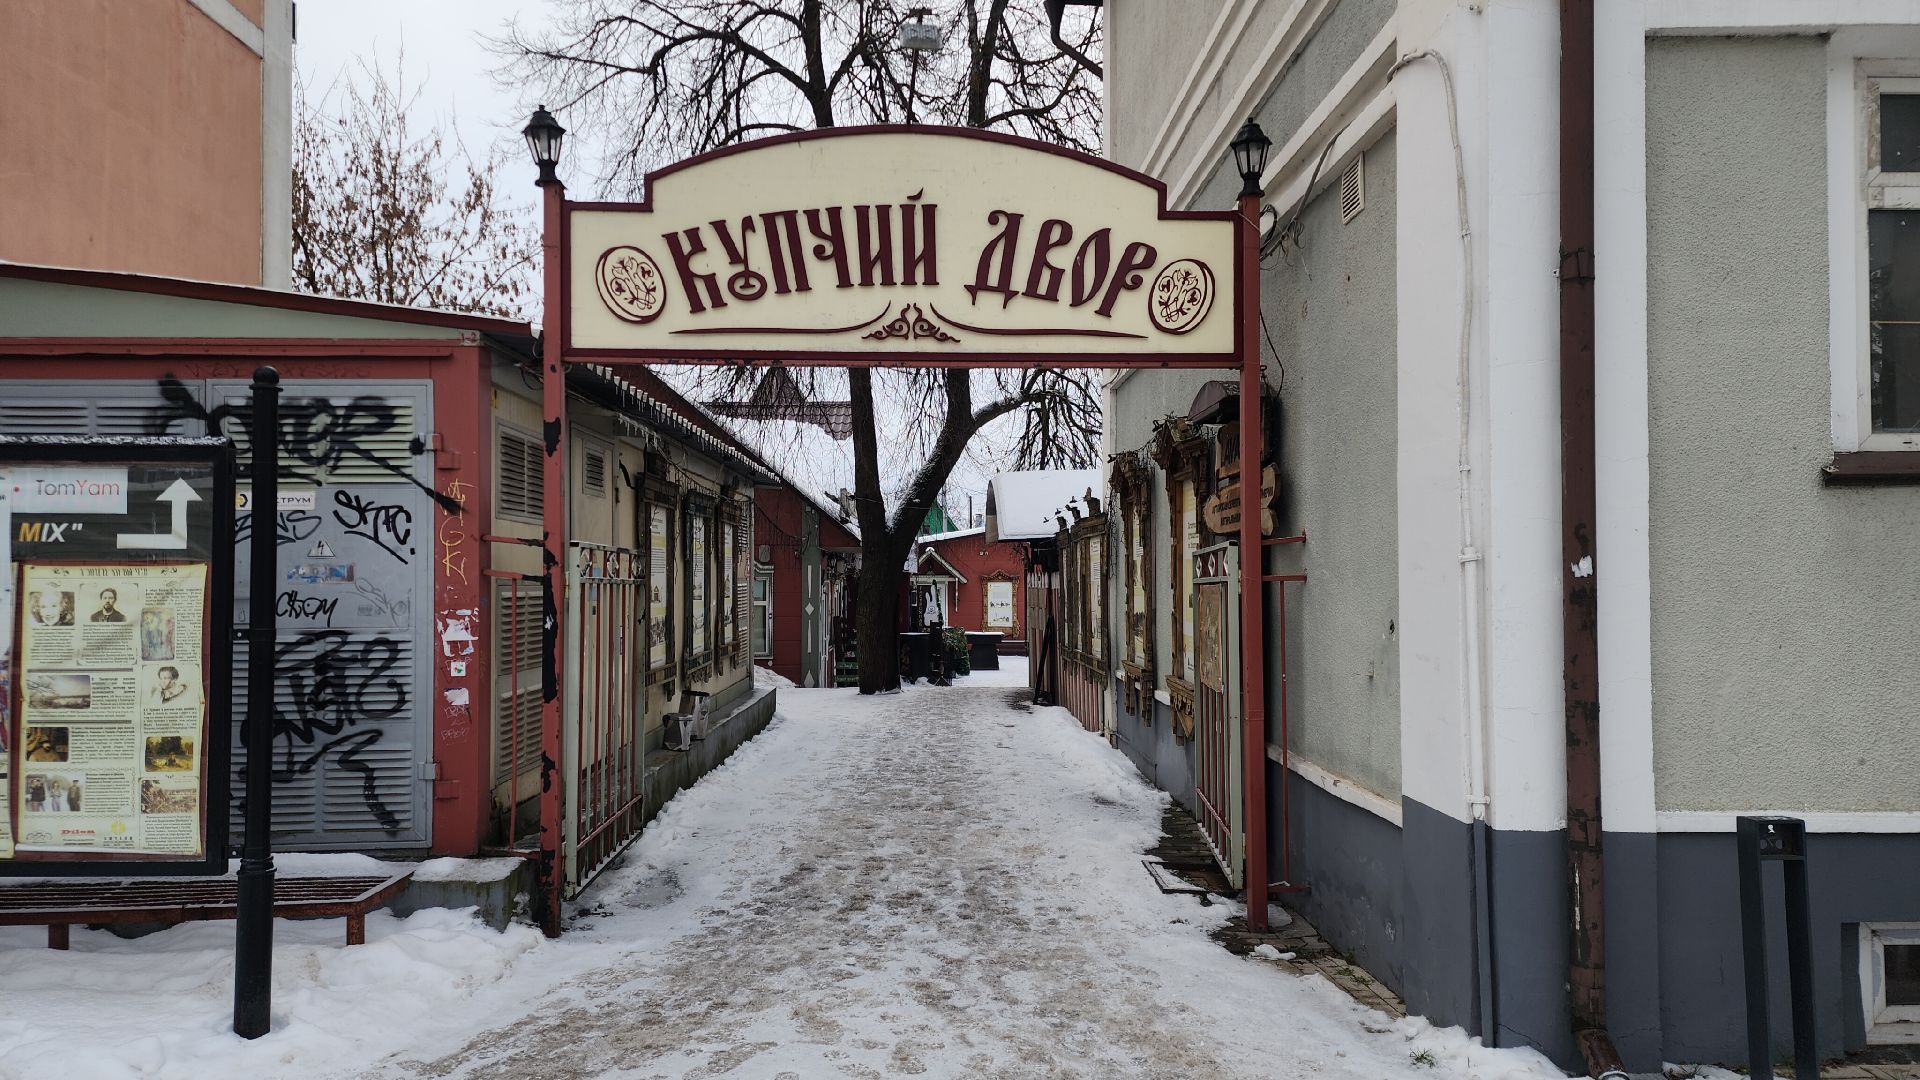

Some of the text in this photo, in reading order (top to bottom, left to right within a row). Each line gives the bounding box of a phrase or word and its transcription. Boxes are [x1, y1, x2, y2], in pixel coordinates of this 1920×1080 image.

[661, 187, 1159, 319] КУПЧИЙ ДВОР
[36, 479, 120, 496] TomYam
